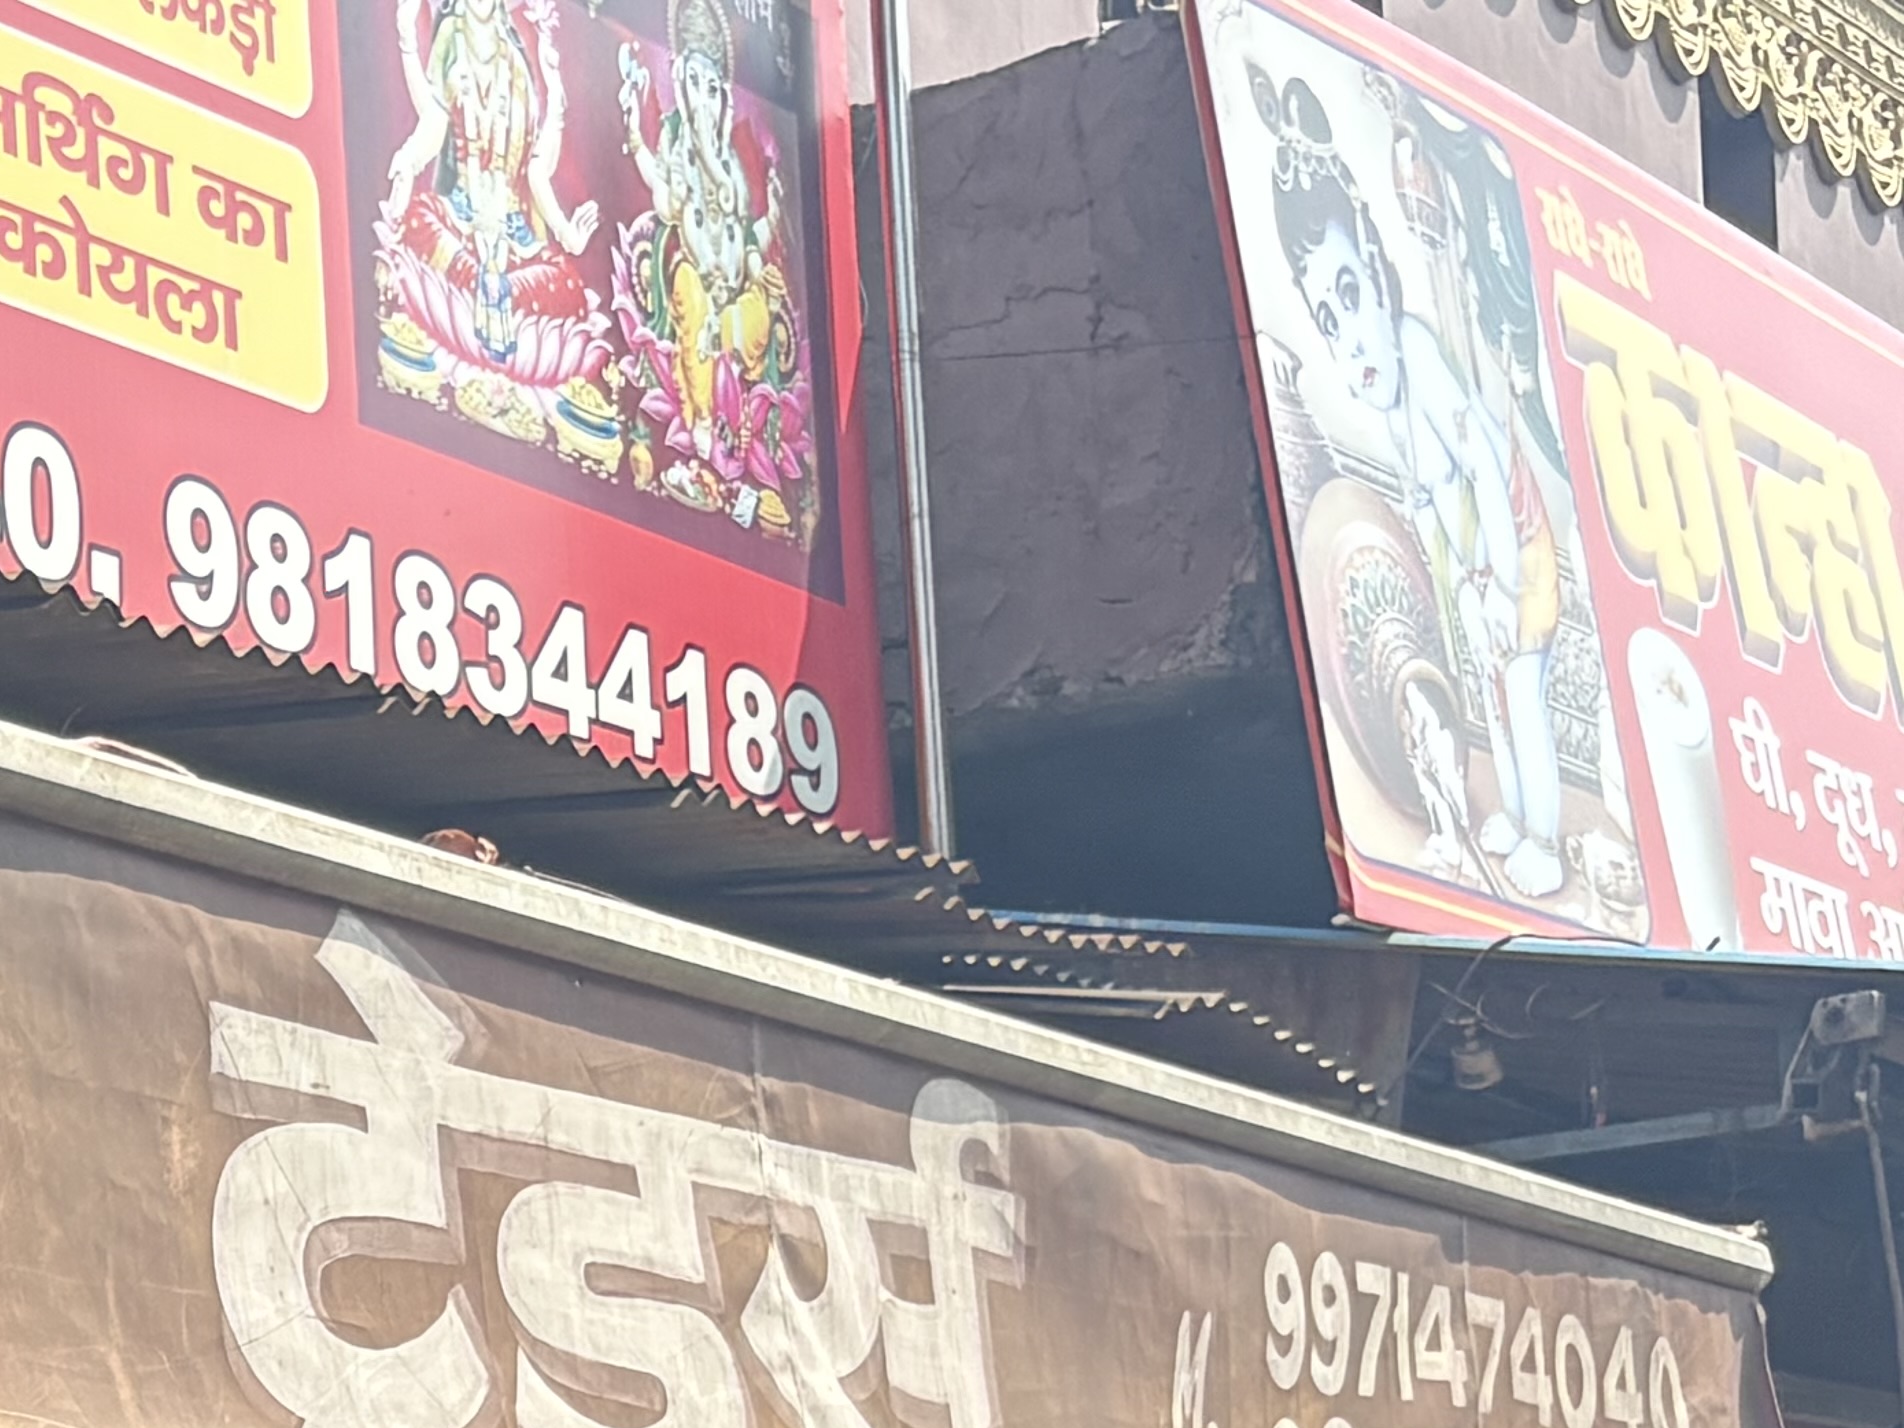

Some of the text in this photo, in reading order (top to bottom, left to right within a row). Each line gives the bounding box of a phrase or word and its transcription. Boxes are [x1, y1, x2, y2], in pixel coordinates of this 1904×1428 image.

[192, 164, 293, 264] का
[163, 473, 841, 816] 9818344189
[1728, 696, 1898, 878] घी, दूध,
[1749, 856, 1857, 960] मावा
